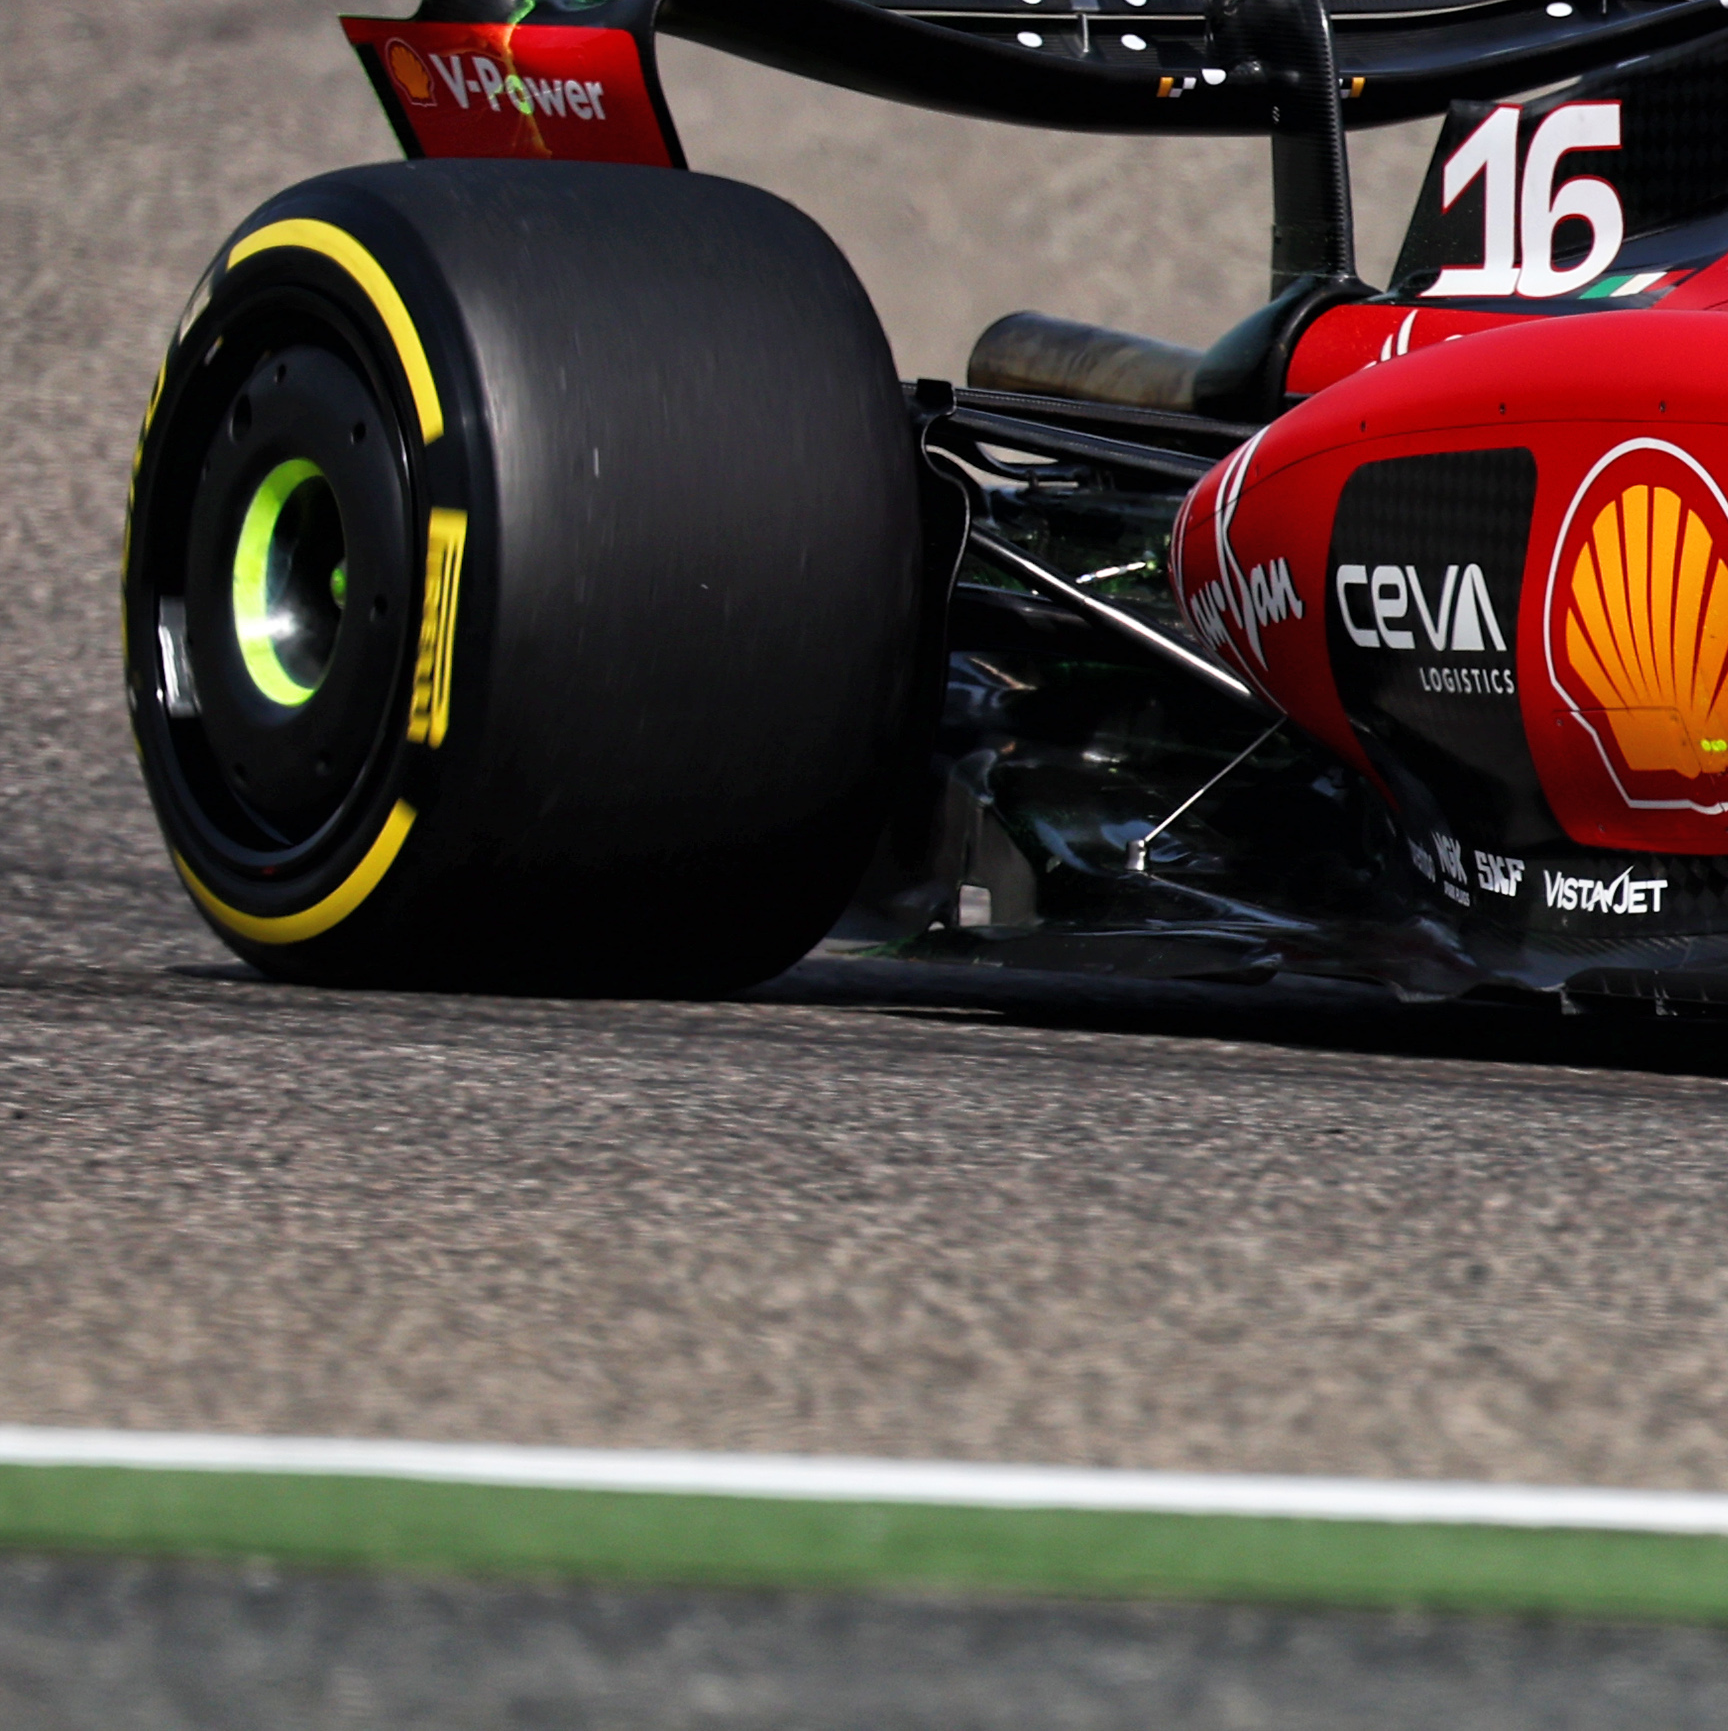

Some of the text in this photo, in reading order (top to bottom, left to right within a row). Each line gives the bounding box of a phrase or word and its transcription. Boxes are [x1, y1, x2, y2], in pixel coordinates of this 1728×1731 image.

[428, 52, 607, 121] V-Power
[1418, 99, 1624, 298] 16
[1336, 562, 1508, 652] CEVA
[1420, 667, 1516, 696] LOGISTICS
[1474, 849, 1526, 897] SKF
[1543, 864, 1668, 914] VISTAJET
